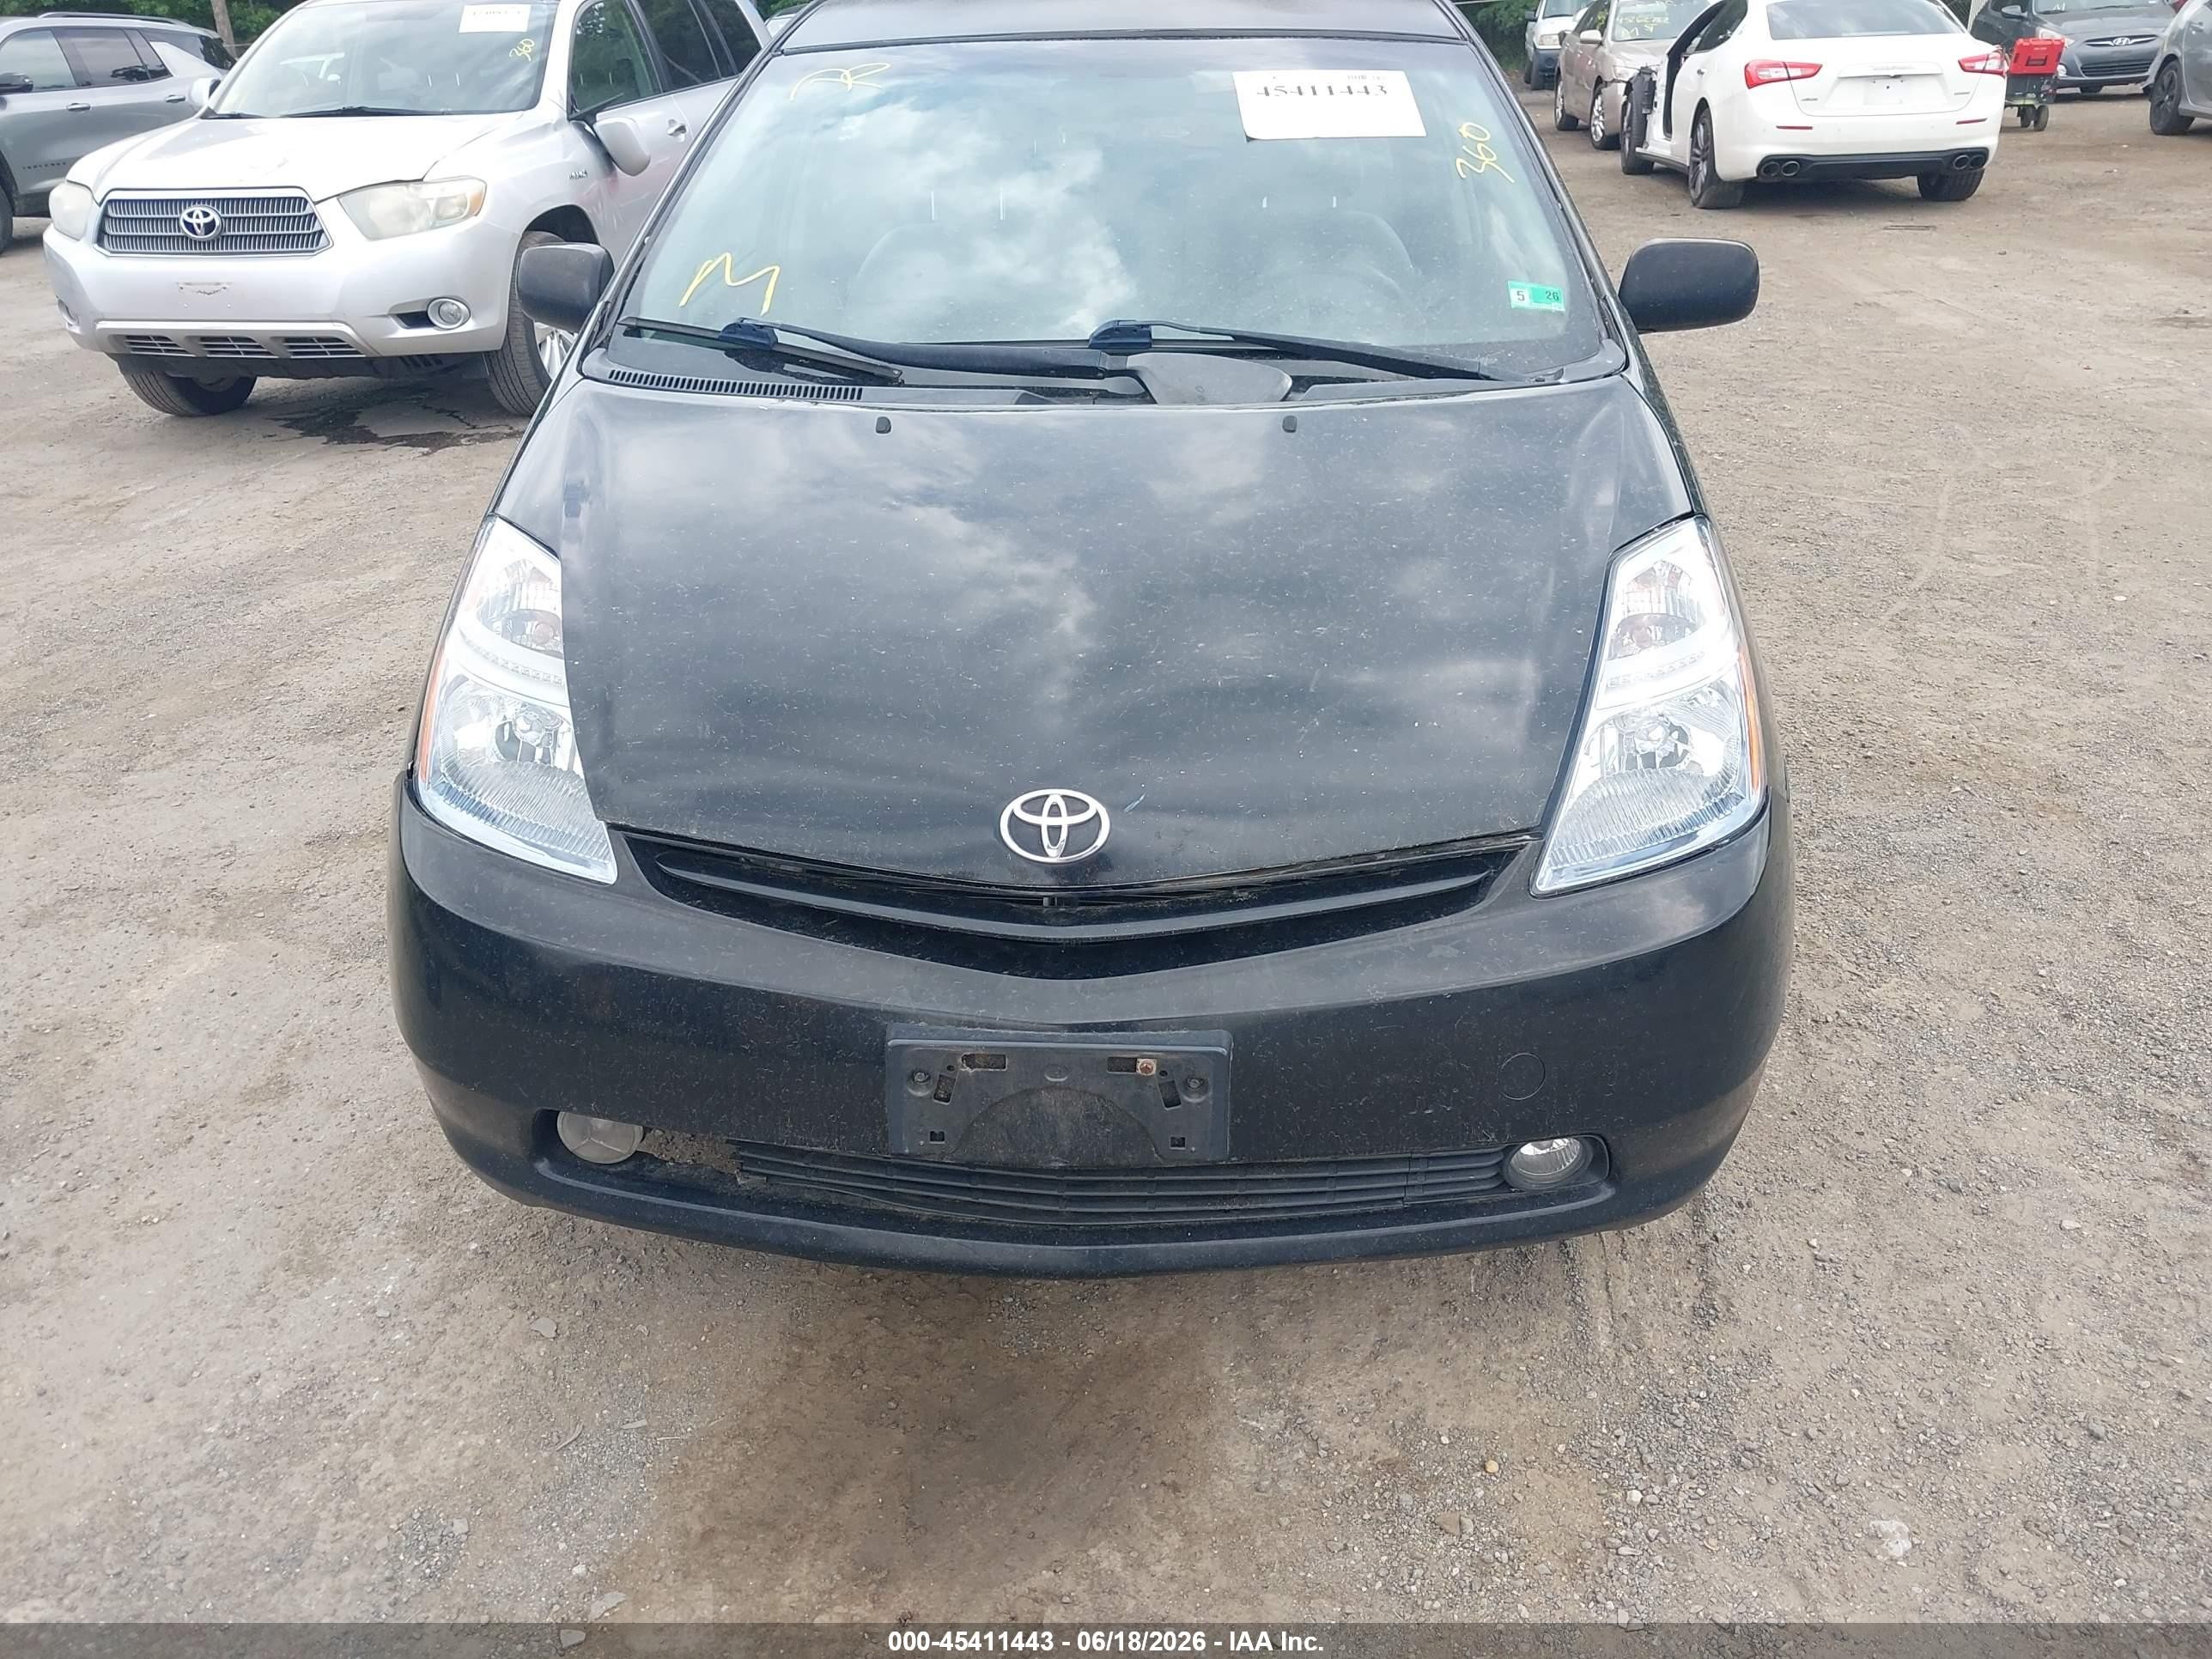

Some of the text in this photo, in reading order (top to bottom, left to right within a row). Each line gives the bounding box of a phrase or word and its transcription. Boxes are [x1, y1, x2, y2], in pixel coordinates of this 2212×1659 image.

[508, 38, 535, 62] 360
[1455, 121, 1516, 183] 360
[678, 252, 781, 317] M
[1516, 290, 1559, 301] 5 26
